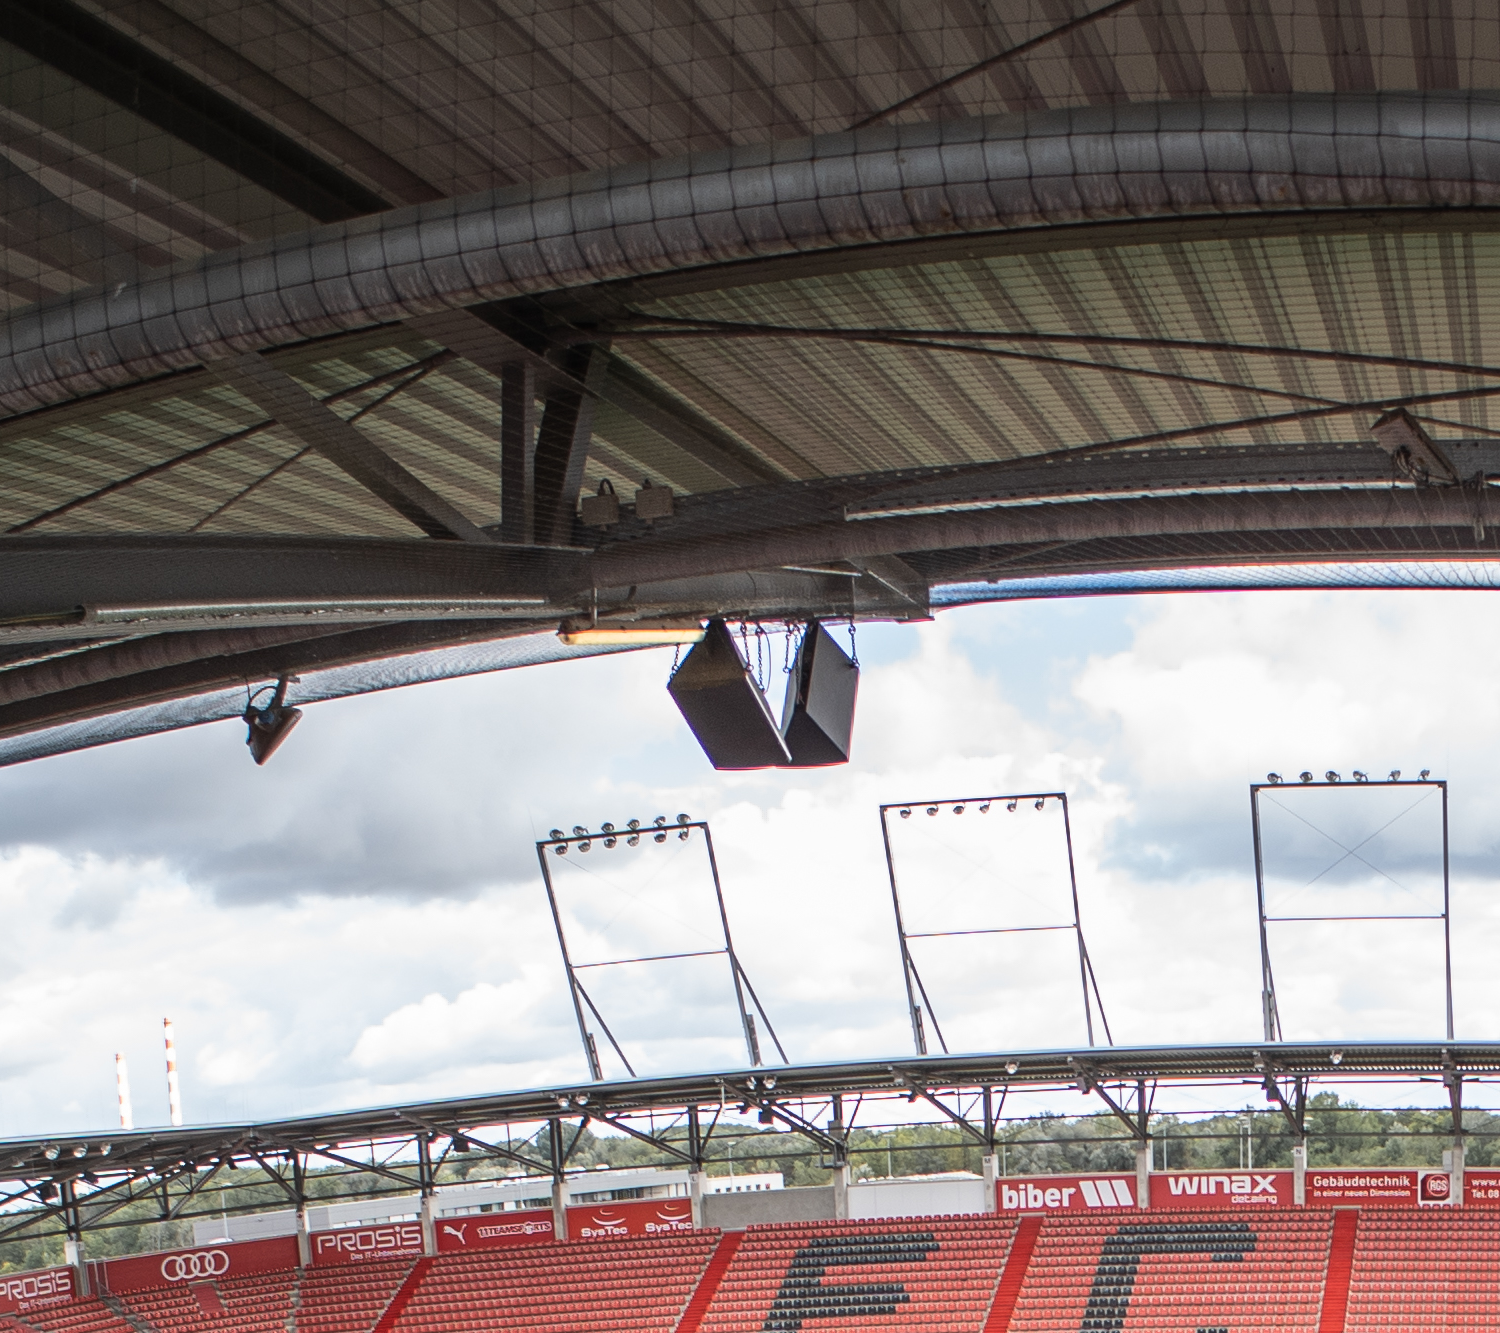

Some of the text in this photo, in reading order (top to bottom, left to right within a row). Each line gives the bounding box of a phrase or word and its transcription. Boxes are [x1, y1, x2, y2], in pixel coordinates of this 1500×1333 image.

[1313, 1176, 1411, 1187] Gebäudetechnik
[1429, 1180, 1448, 1191] RGS
[1002, 1184, 1076, 1210] biber
[1313, 1189, 1322, 1197] in
[1370, 1189, 1411, 1197] Dimension
[1231, 1194, 1278, 1205] detailing
[581, 1226, 628, 1238] SysTec
[645, 1221, 693, 1233] SysTec
[350, 1252, 364, 1261] Das
